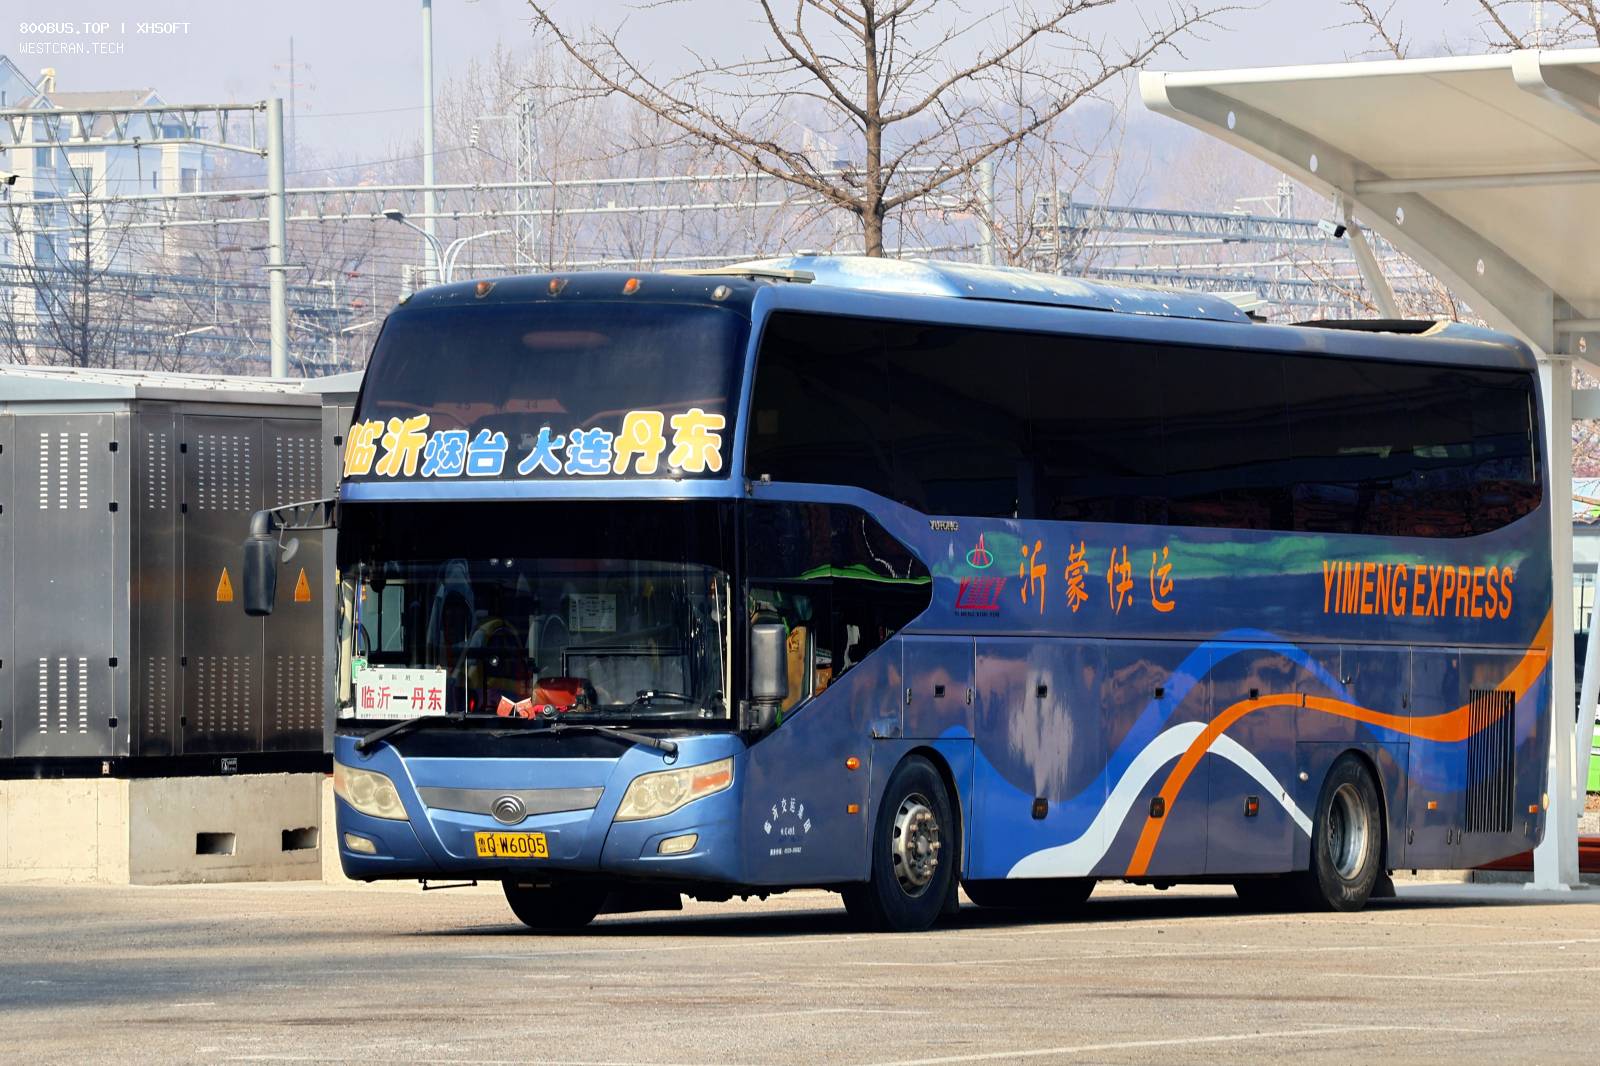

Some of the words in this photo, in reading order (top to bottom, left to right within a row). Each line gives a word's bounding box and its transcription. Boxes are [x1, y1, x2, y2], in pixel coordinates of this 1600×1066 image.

[344, 413, 430, 477] 临沂
[421, 428, 508, 477] 烟台
[613, 408, 725, 474] 丹东
[1019, 540, 1175, 615] 沂蒙快运
[1323, 560, 1408, 617] YIMENG
[1412, 564, 1513, 620] EXPRESS
